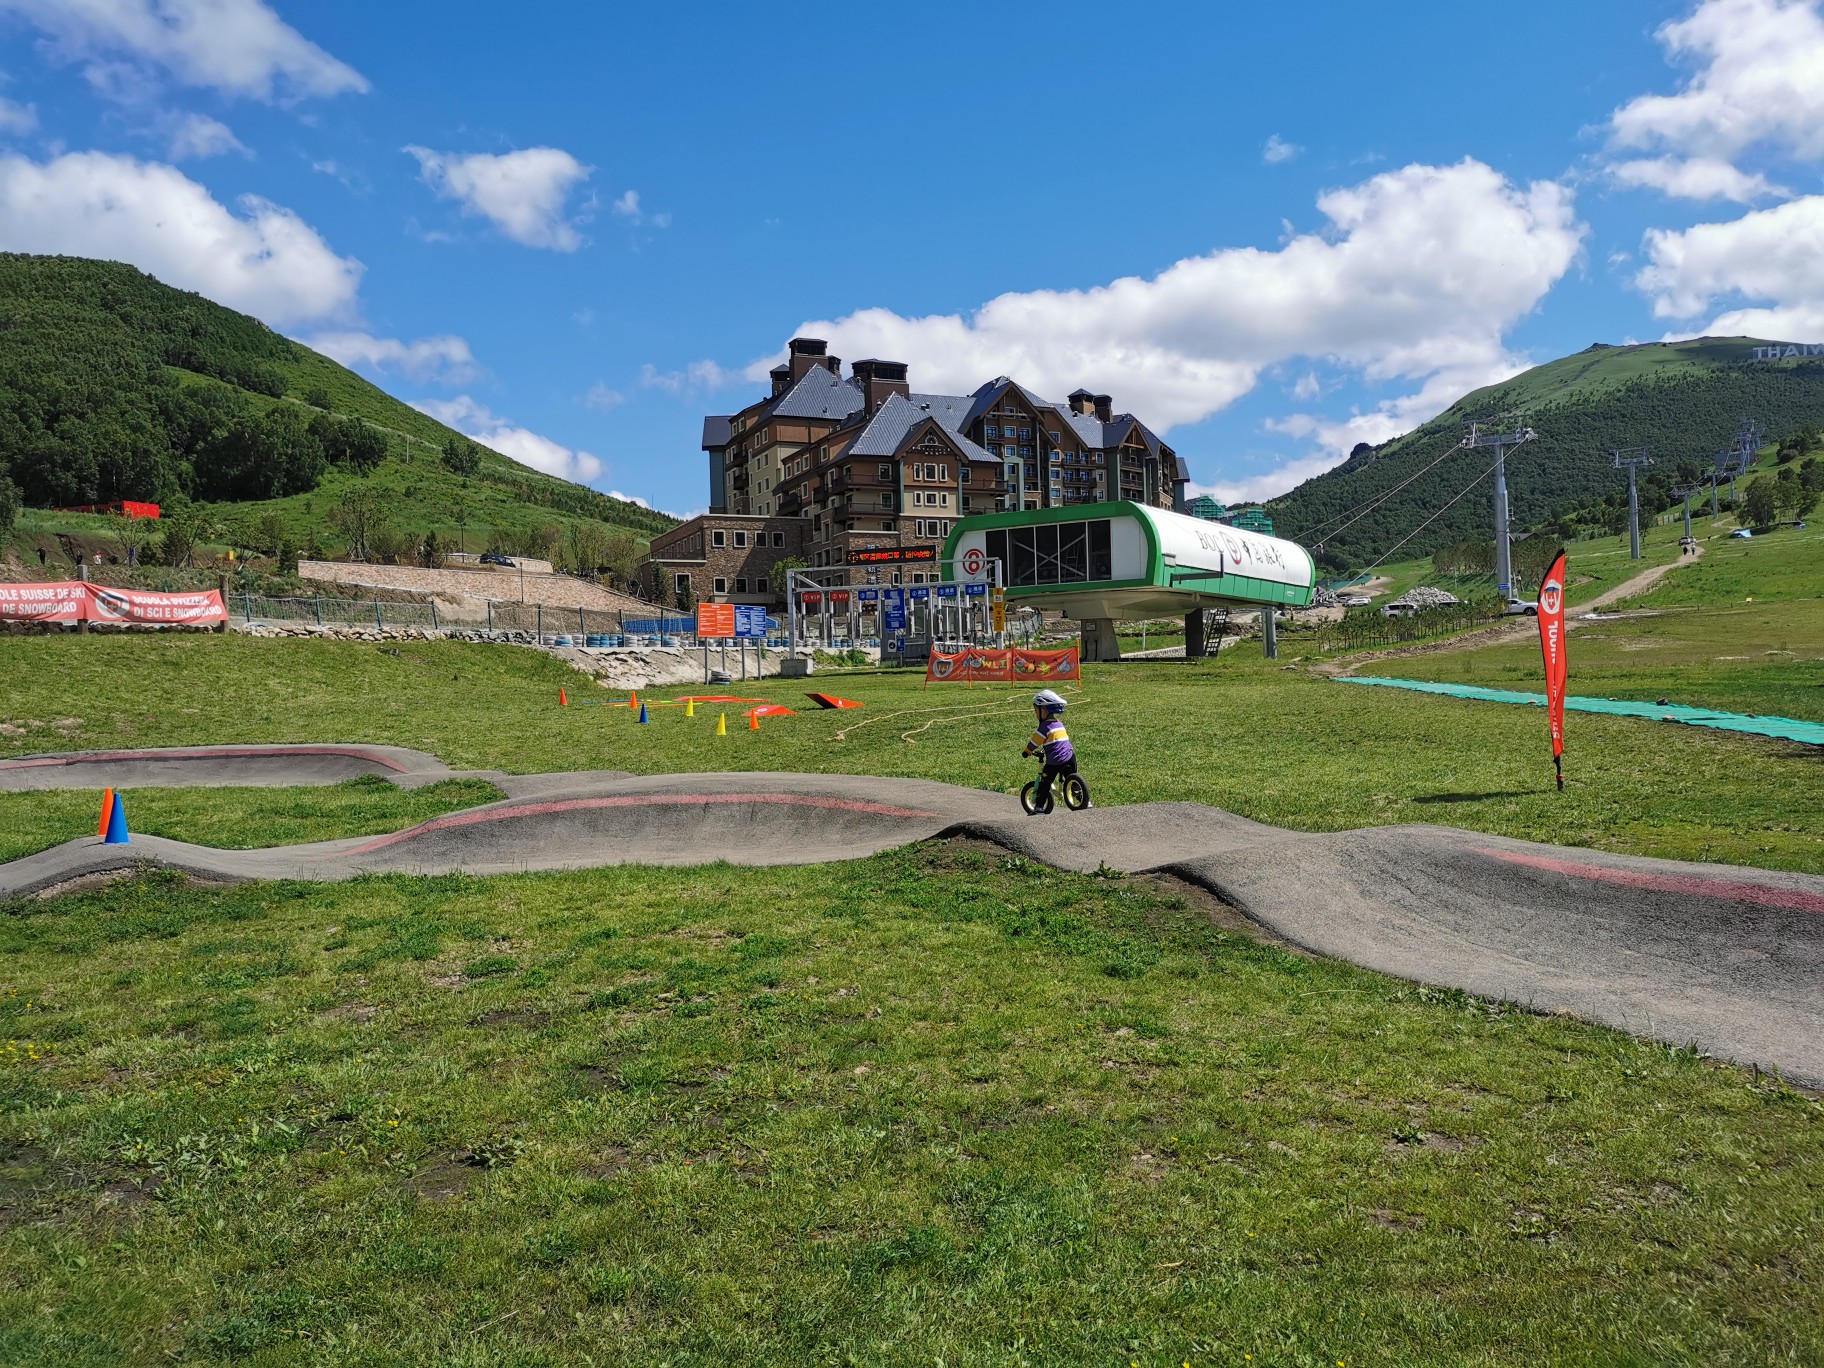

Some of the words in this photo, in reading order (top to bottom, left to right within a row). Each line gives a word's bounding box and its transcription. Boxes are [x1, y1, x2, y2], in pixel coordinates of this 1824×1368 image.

[1195, 530, 1225, 553] BOC
[20, 588, 55, 601] SUISSE
[57, 588, 69, 599] DE
[70, 587, 86, 599] SKI
[132, 595, 171, 605] SCUOLA
[2, 603, 16, 614] DE
[18, 601, 77, 615] SNOWBOARD
[134, 606, 144, 617] DI
[147, 607, 162, 618] SCI
[165, 608, 171, 618] E
[174, 604, 222, 619] SNOWBOARD
